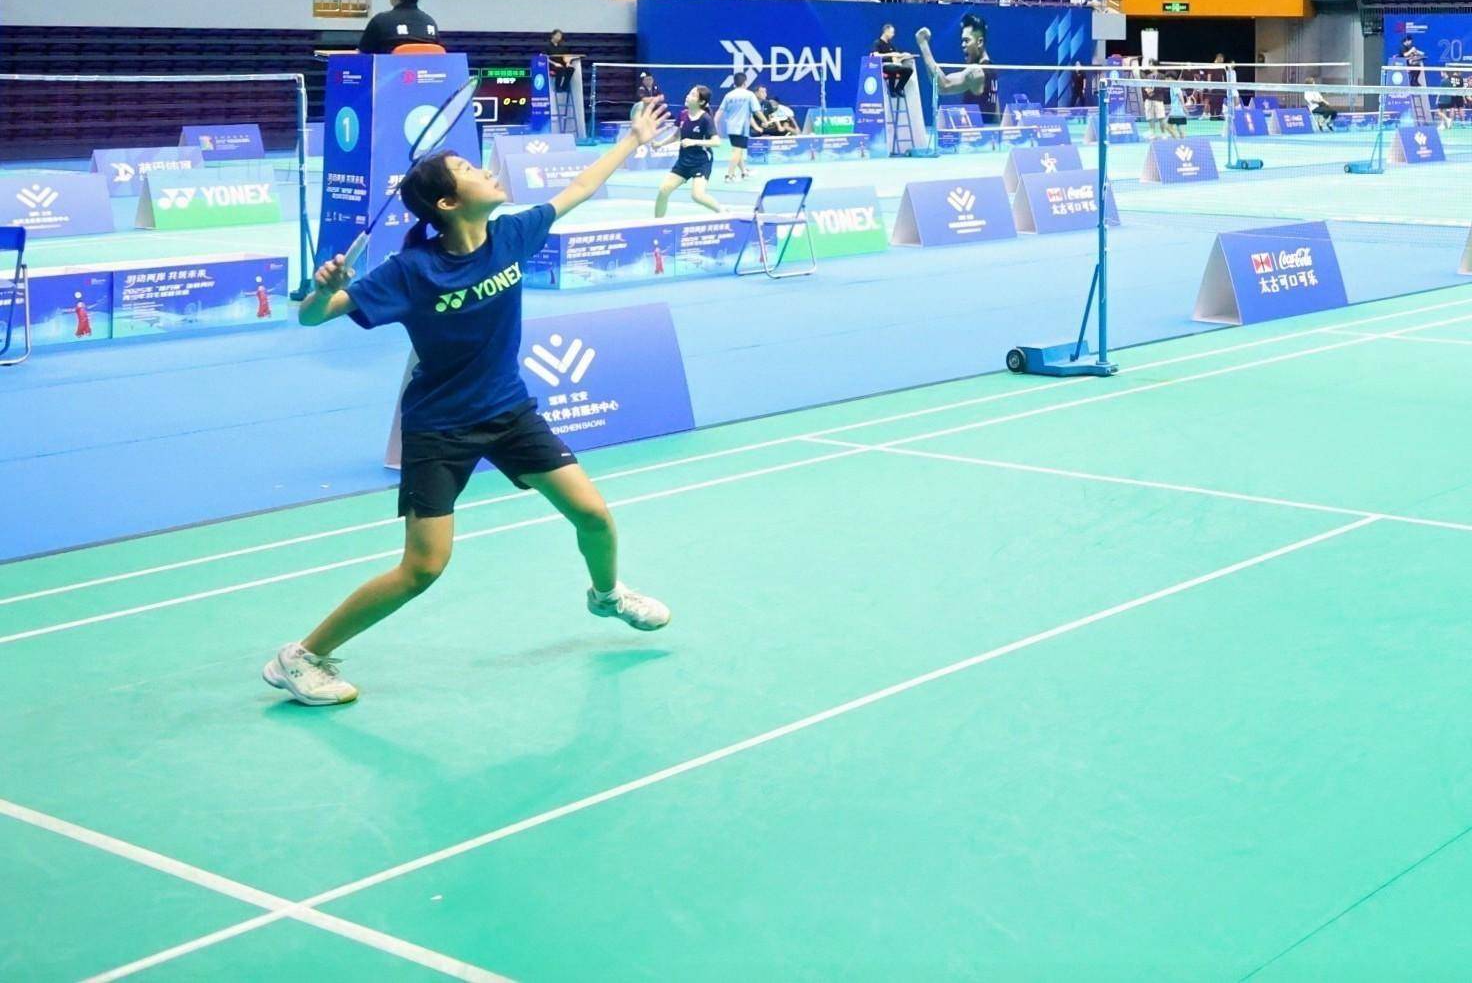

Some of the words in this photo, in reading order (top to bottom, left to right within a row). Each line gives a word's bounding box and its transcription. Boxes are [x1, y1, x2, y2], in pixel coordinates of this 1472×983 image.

[770, 46, 841, 81] DAN
[342, 117, 350, 143] 1
[201, 184, 273, 207] YONEX
[813, 207, 880, 235] YONEX
[472, 262, 523, 300] YONEX
[1259, 270, 1318, 294] 太古可口可乐
